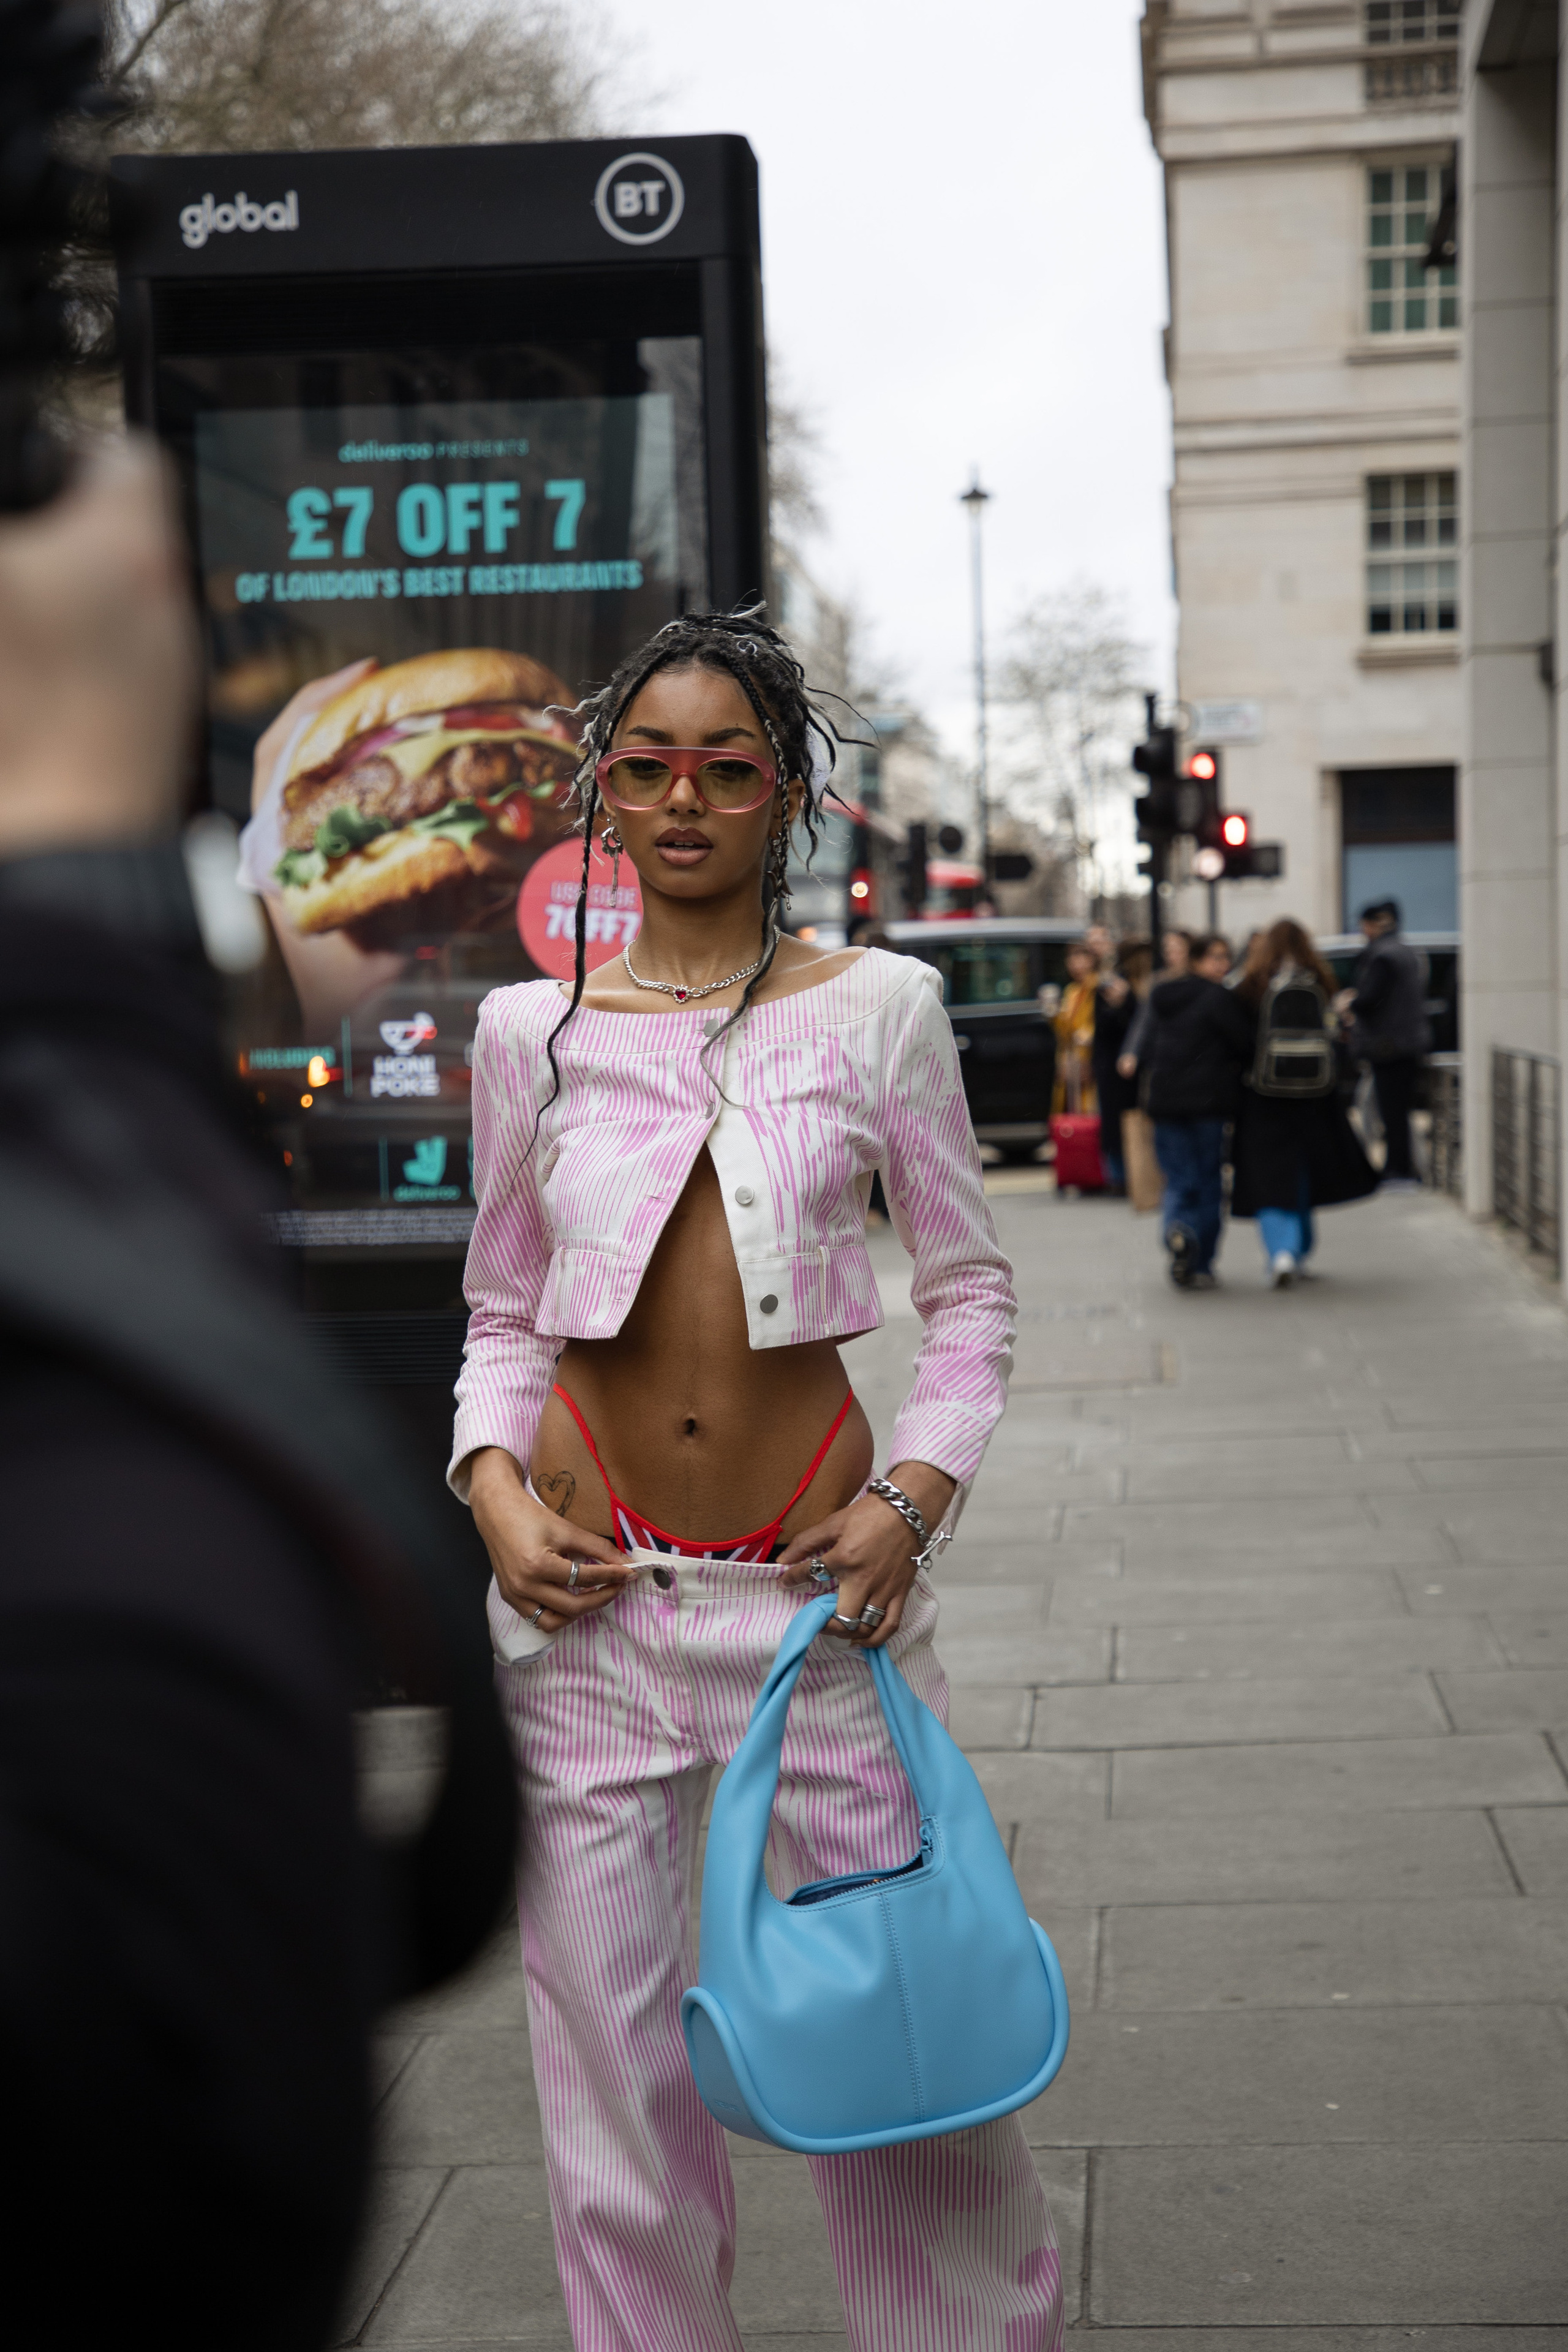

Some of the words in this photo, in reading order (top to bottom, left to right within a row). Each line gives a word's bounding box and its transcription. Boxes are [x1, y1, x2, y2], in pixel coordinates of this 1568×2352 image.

[179, 191, 300, 249] global
[614, 180, 666, 218] BT
[338, 440, 432, 462] deliveroo
[435, 438, 529, 459] PRESENTS
[287, 487, 373, 559] £7
[397, 481, 520, 557] OFF
[545, 479, 586, 551] 7
[236, 571, 271, 603] OF
[273, 567, 401, 602] LONDON'S
[403, 566, 465, 598] BEST
[467, 559, 644, 595] RESTAURANTS
